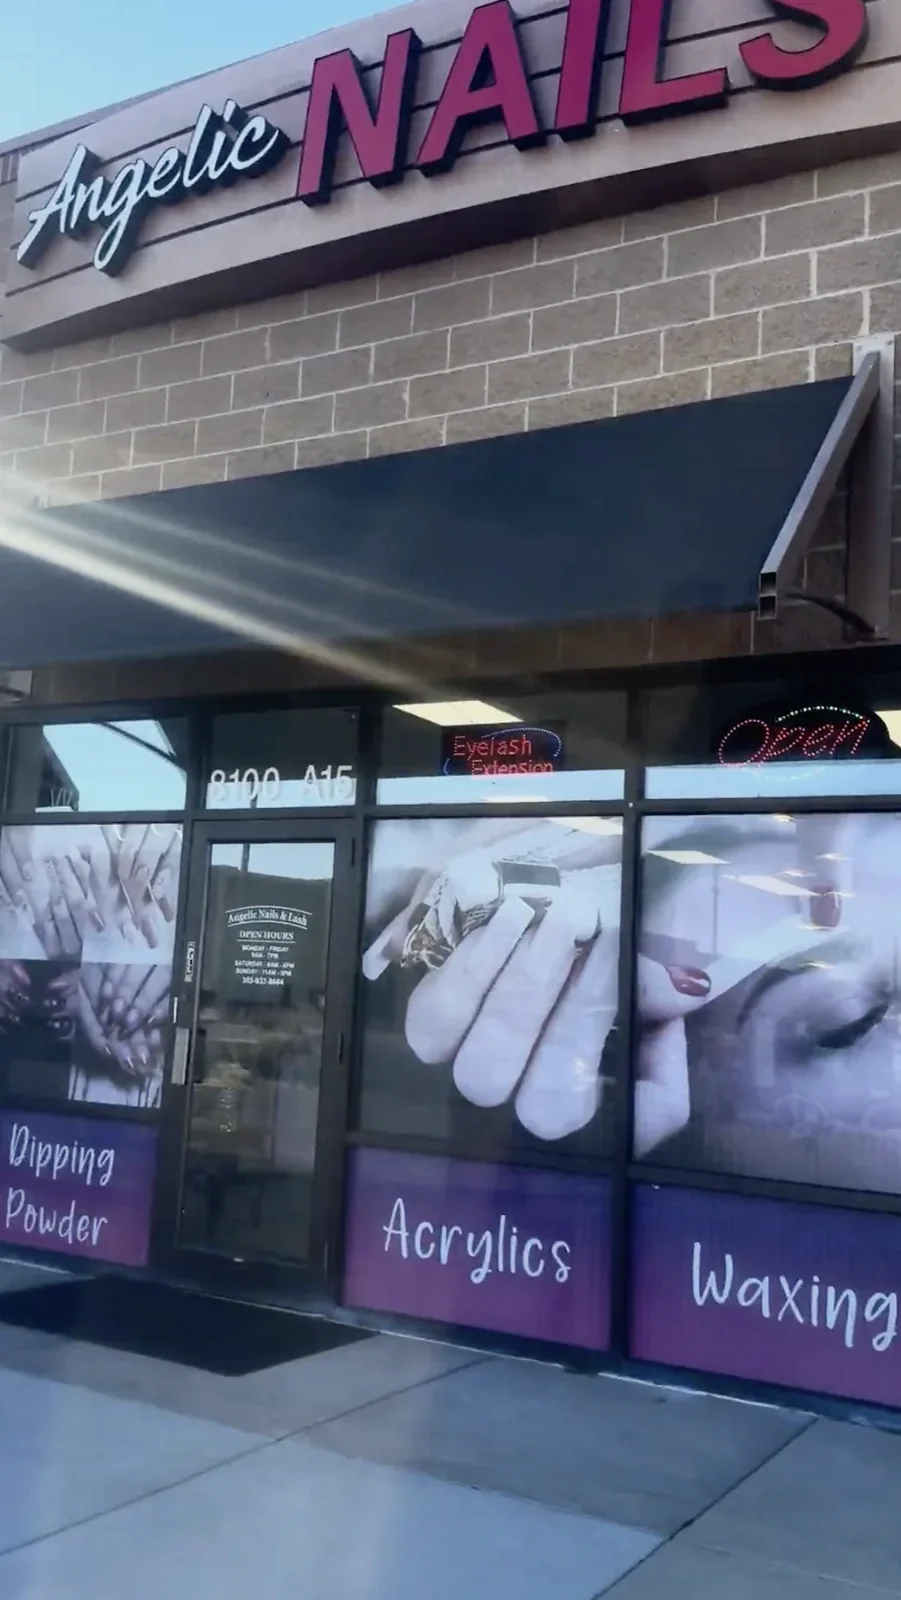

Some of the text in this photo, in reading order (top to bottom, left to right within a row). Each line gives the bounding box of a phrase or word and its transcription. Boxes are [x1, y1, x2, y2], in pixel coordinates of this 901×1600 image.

[16, 0, 866, 269] Angelic NAILS
[453, 734, 532, 761] Eyelash
[471, 759, 554, 777] Extension
[718, 718, 871, 771] Open
[210, 764, 353, 801] 8100 A15
[228, 909, 258, 924] Angelic
[259, 909, 279, 920] Nails
[288, 912, 308, 927] Lash
[239, 930, 295, 940] OPEN HOURS
[8, 1122, 116, 1187] Dipping
[5, 1186, 109, 1247] Powder
[382, 1196, 572, 1285] Acrylics
[691, 1241, 898, 1352] Waxing
